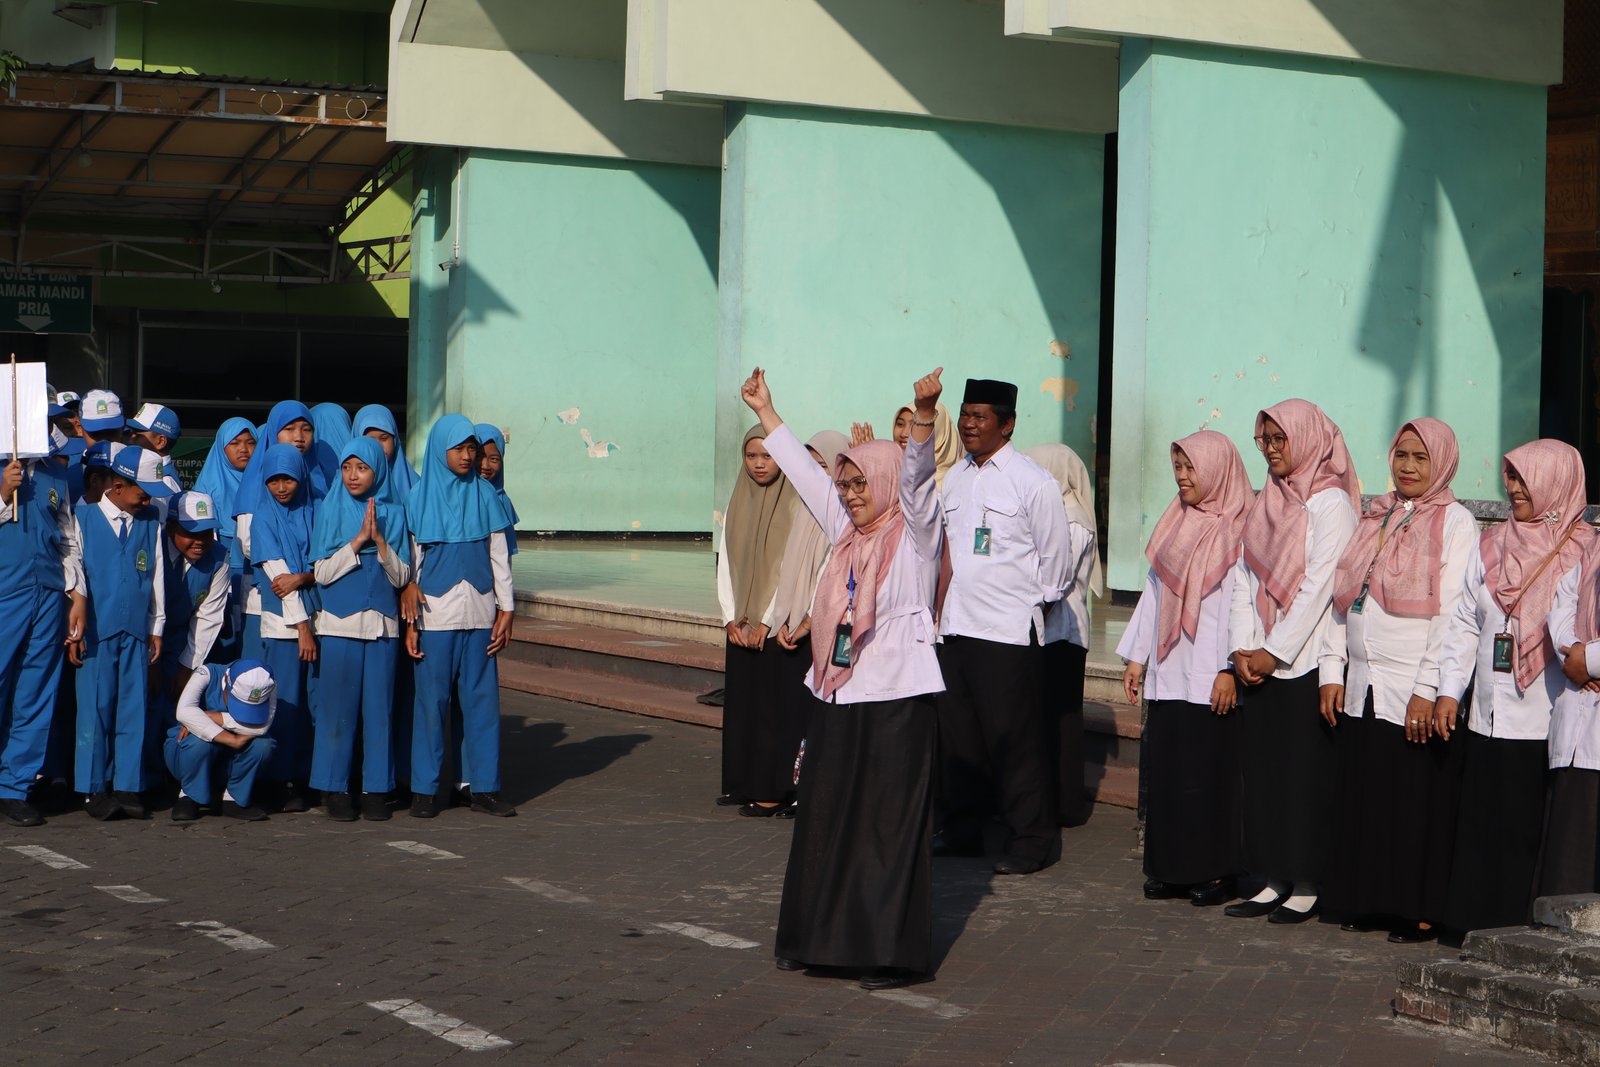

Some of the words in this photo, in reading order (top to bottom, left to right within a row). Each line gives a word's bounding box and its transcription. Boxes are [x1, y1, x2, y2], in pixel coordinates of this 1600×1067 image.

[0, 272, 44, 281] OILET
[39, 285, 85, 300] MANDI
[18, 301, 51, 315] PRIA
